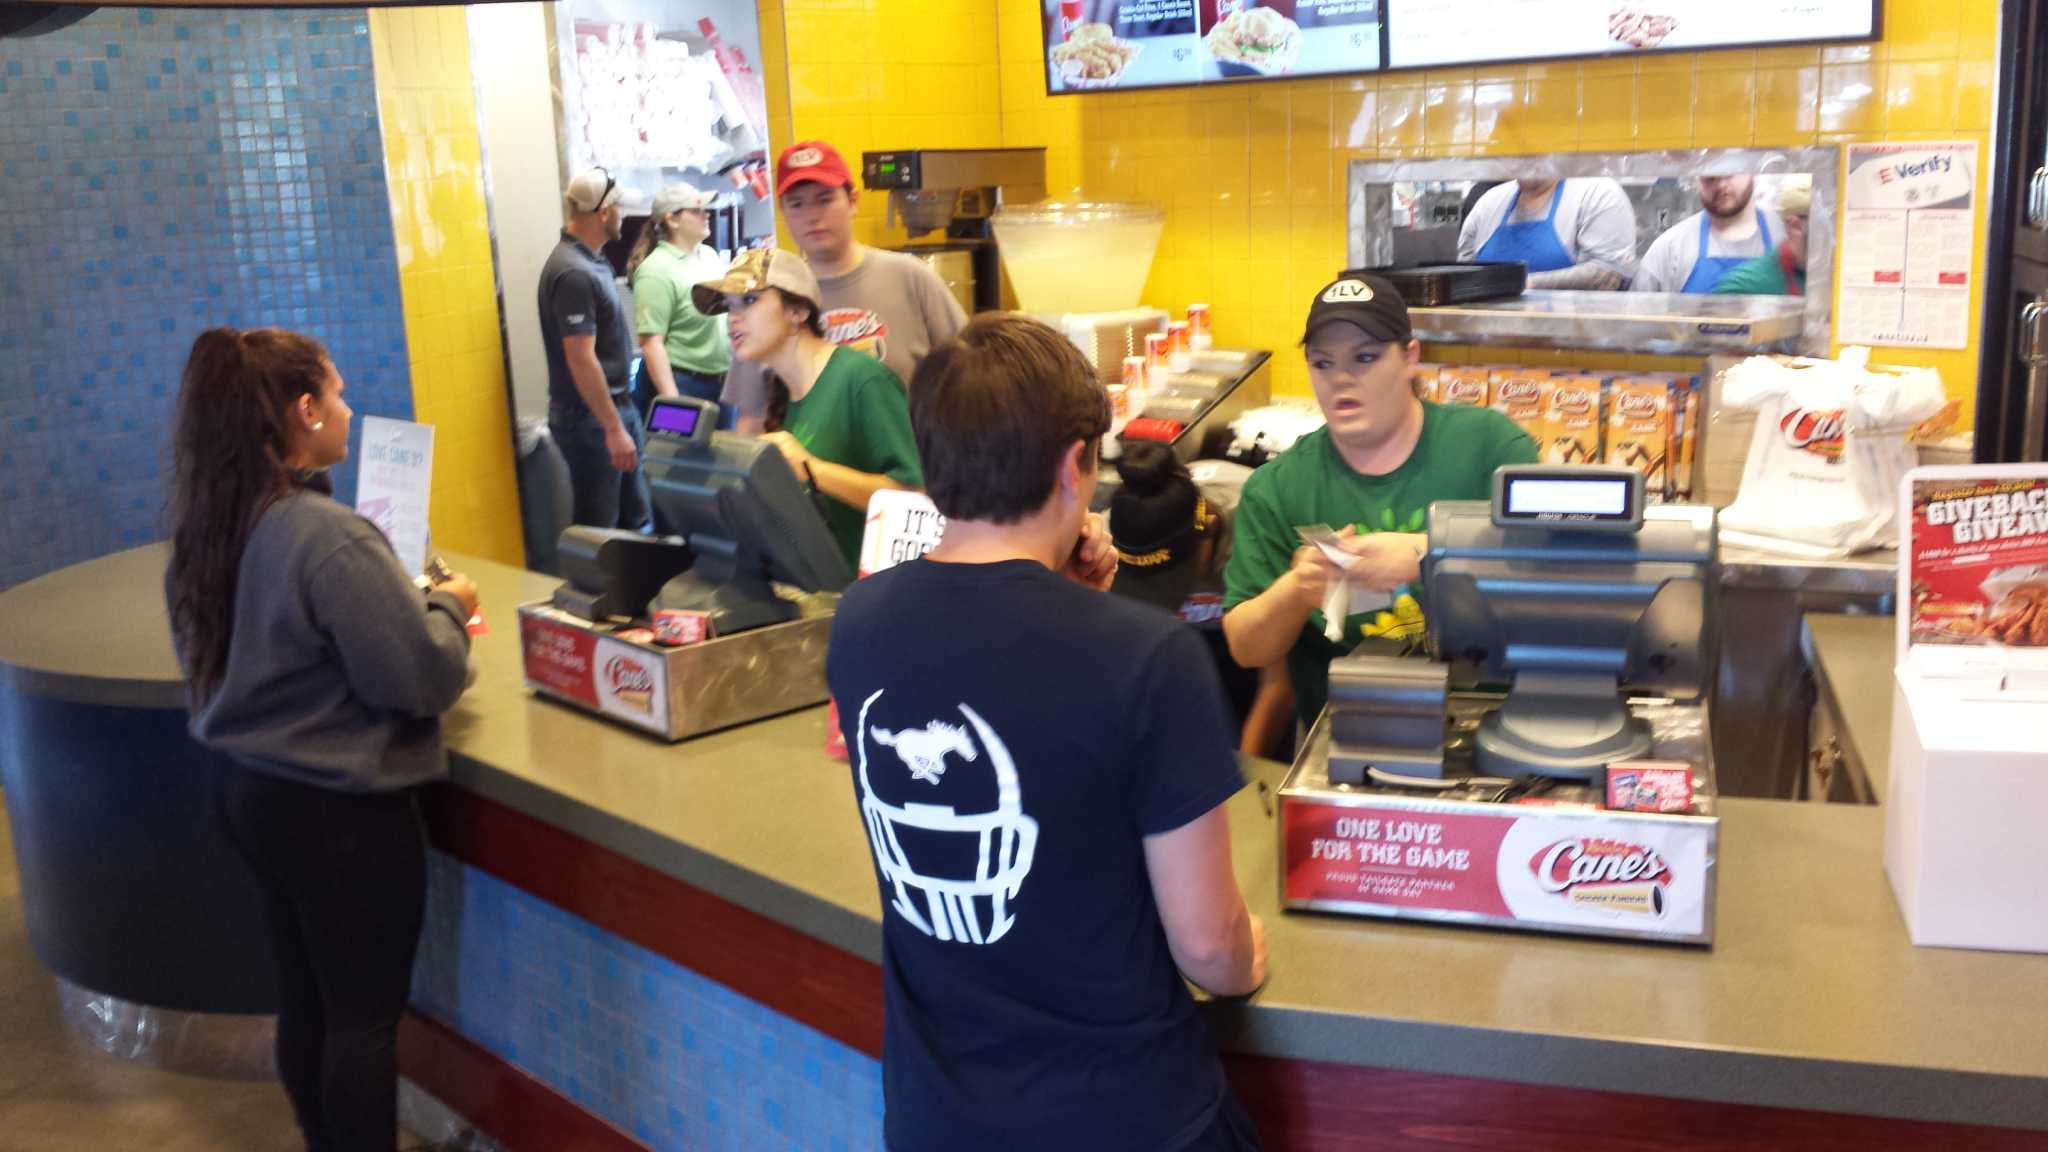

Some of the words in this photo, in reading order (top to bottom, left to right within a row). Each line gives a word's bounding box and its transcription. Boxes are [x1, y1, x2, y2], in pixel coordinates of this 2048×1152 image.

[1895, 155, 1952, 178] Verify
[1927, 487, 2048, 526] GIVEBAC
[1336, 816, 1381, 839] ONE
[1385, 820, 1442, 845] LOVE
[1311, 837, 1352, 861] FOR
[1358, 842, 1401, 865] THE
[1406, 845, 1470, 871] GAME
[1538, 837, 1668, 893] Cane's
